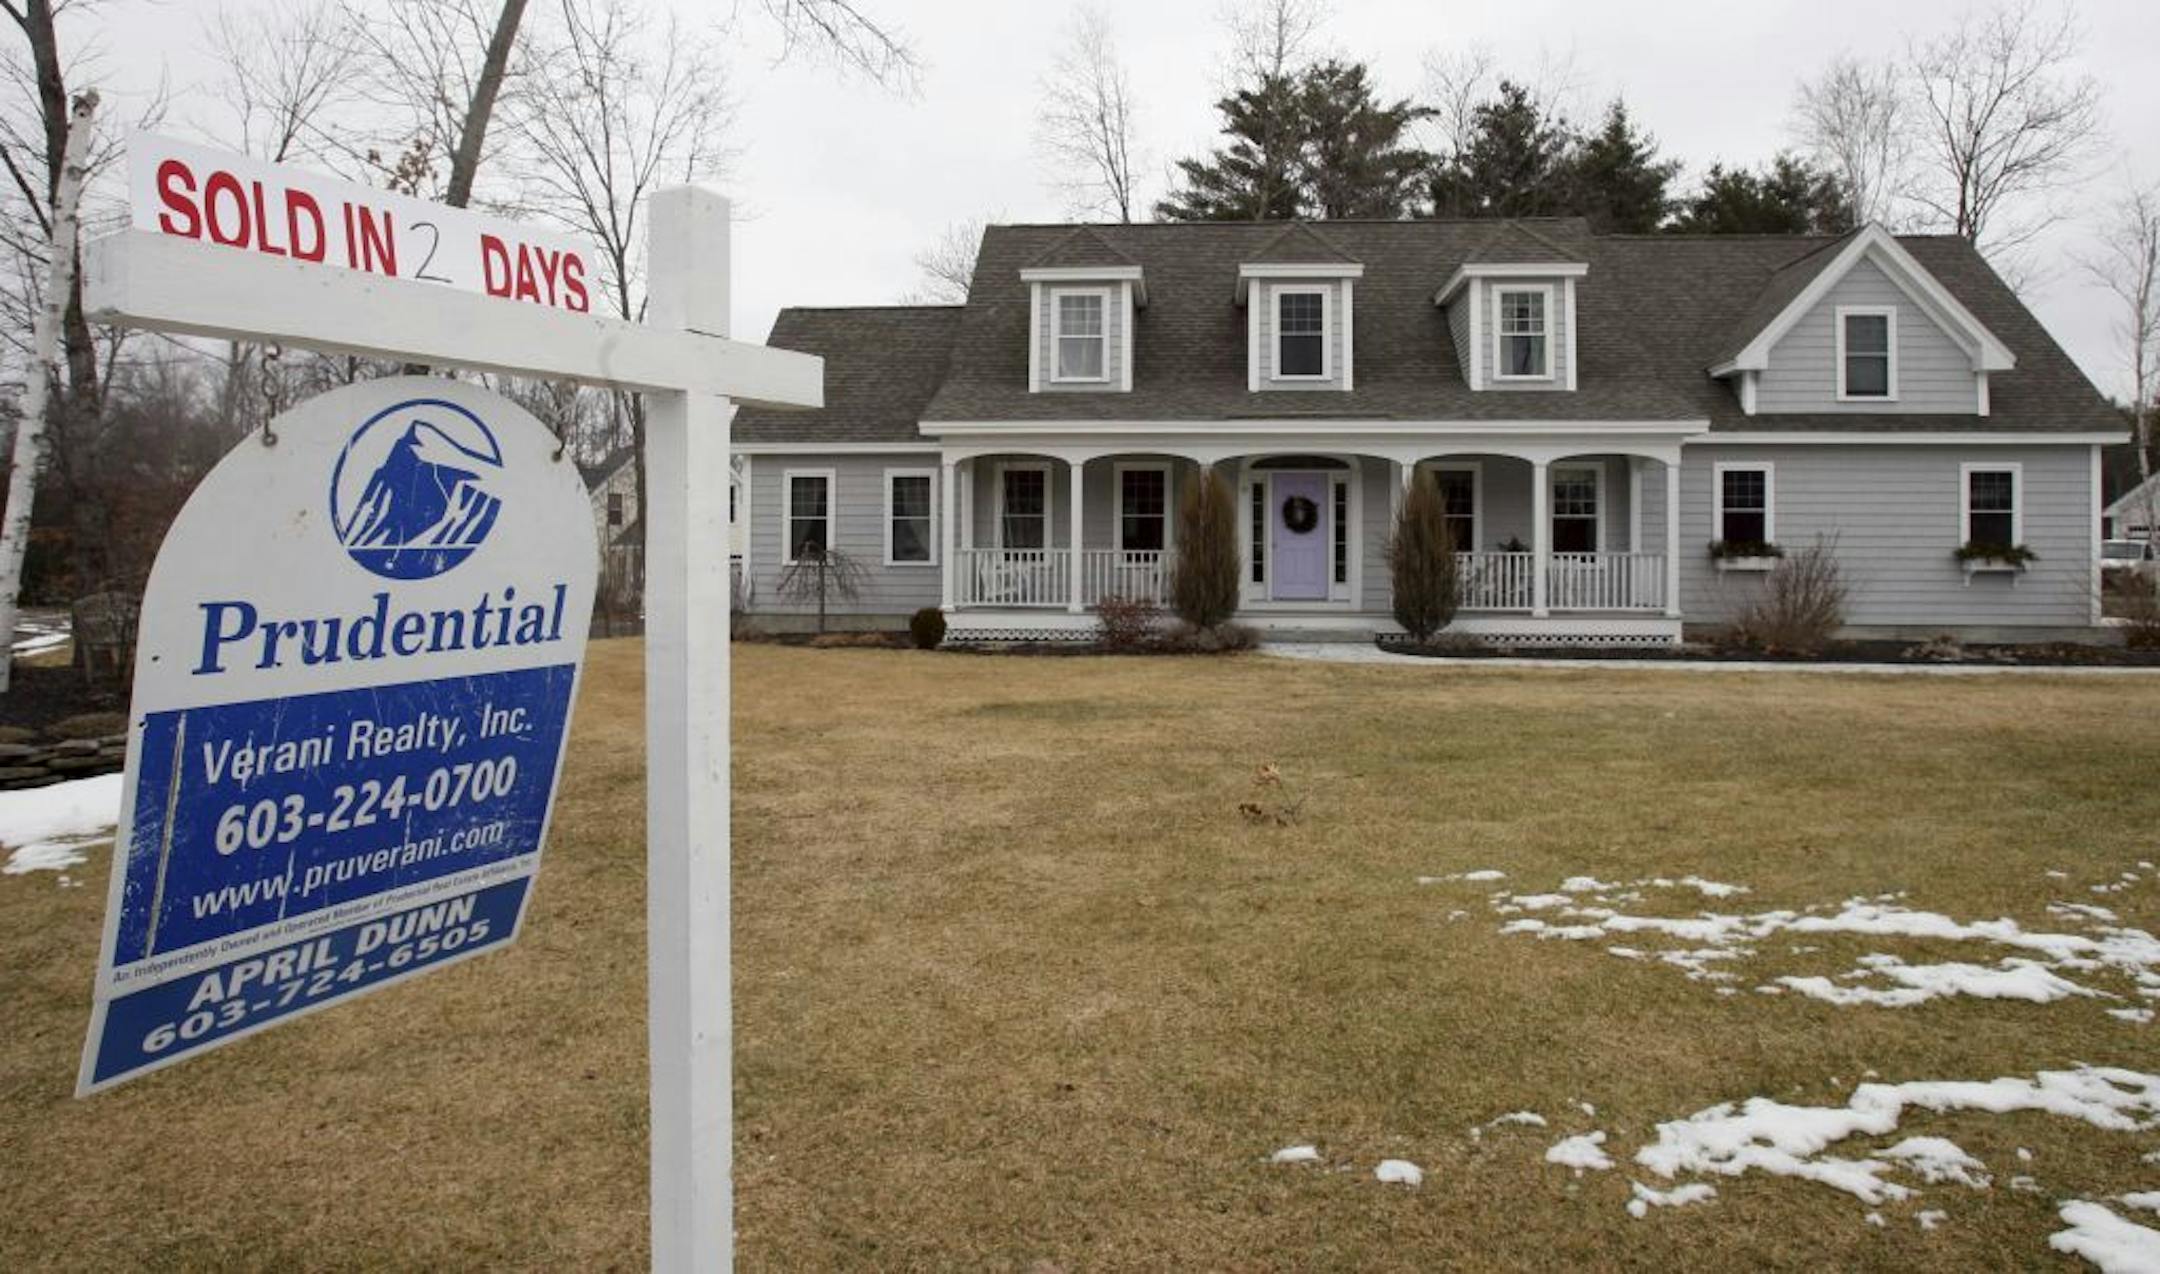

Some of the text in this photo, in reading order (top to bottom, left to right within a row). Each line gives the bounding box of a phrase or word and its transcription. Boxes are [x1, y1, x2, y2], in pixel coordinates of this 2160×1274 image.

[157, 159, 590, 313] SOLD IN 2 DAYS
[191, 584, 568, 676] Prudential
[203, 702, 533, 785] Verani Realty, Inc.
[214, 755, 517, 856] 603-224-0700
[192, 820, 504, 919] www.pruverani.com
[134, 943, 218, 978] Independently
[141, 919, 492, 1055] 603-724-6505
[187, 938, 340, 1012] APRIL
[354, 893, 479, 957] DUNN
